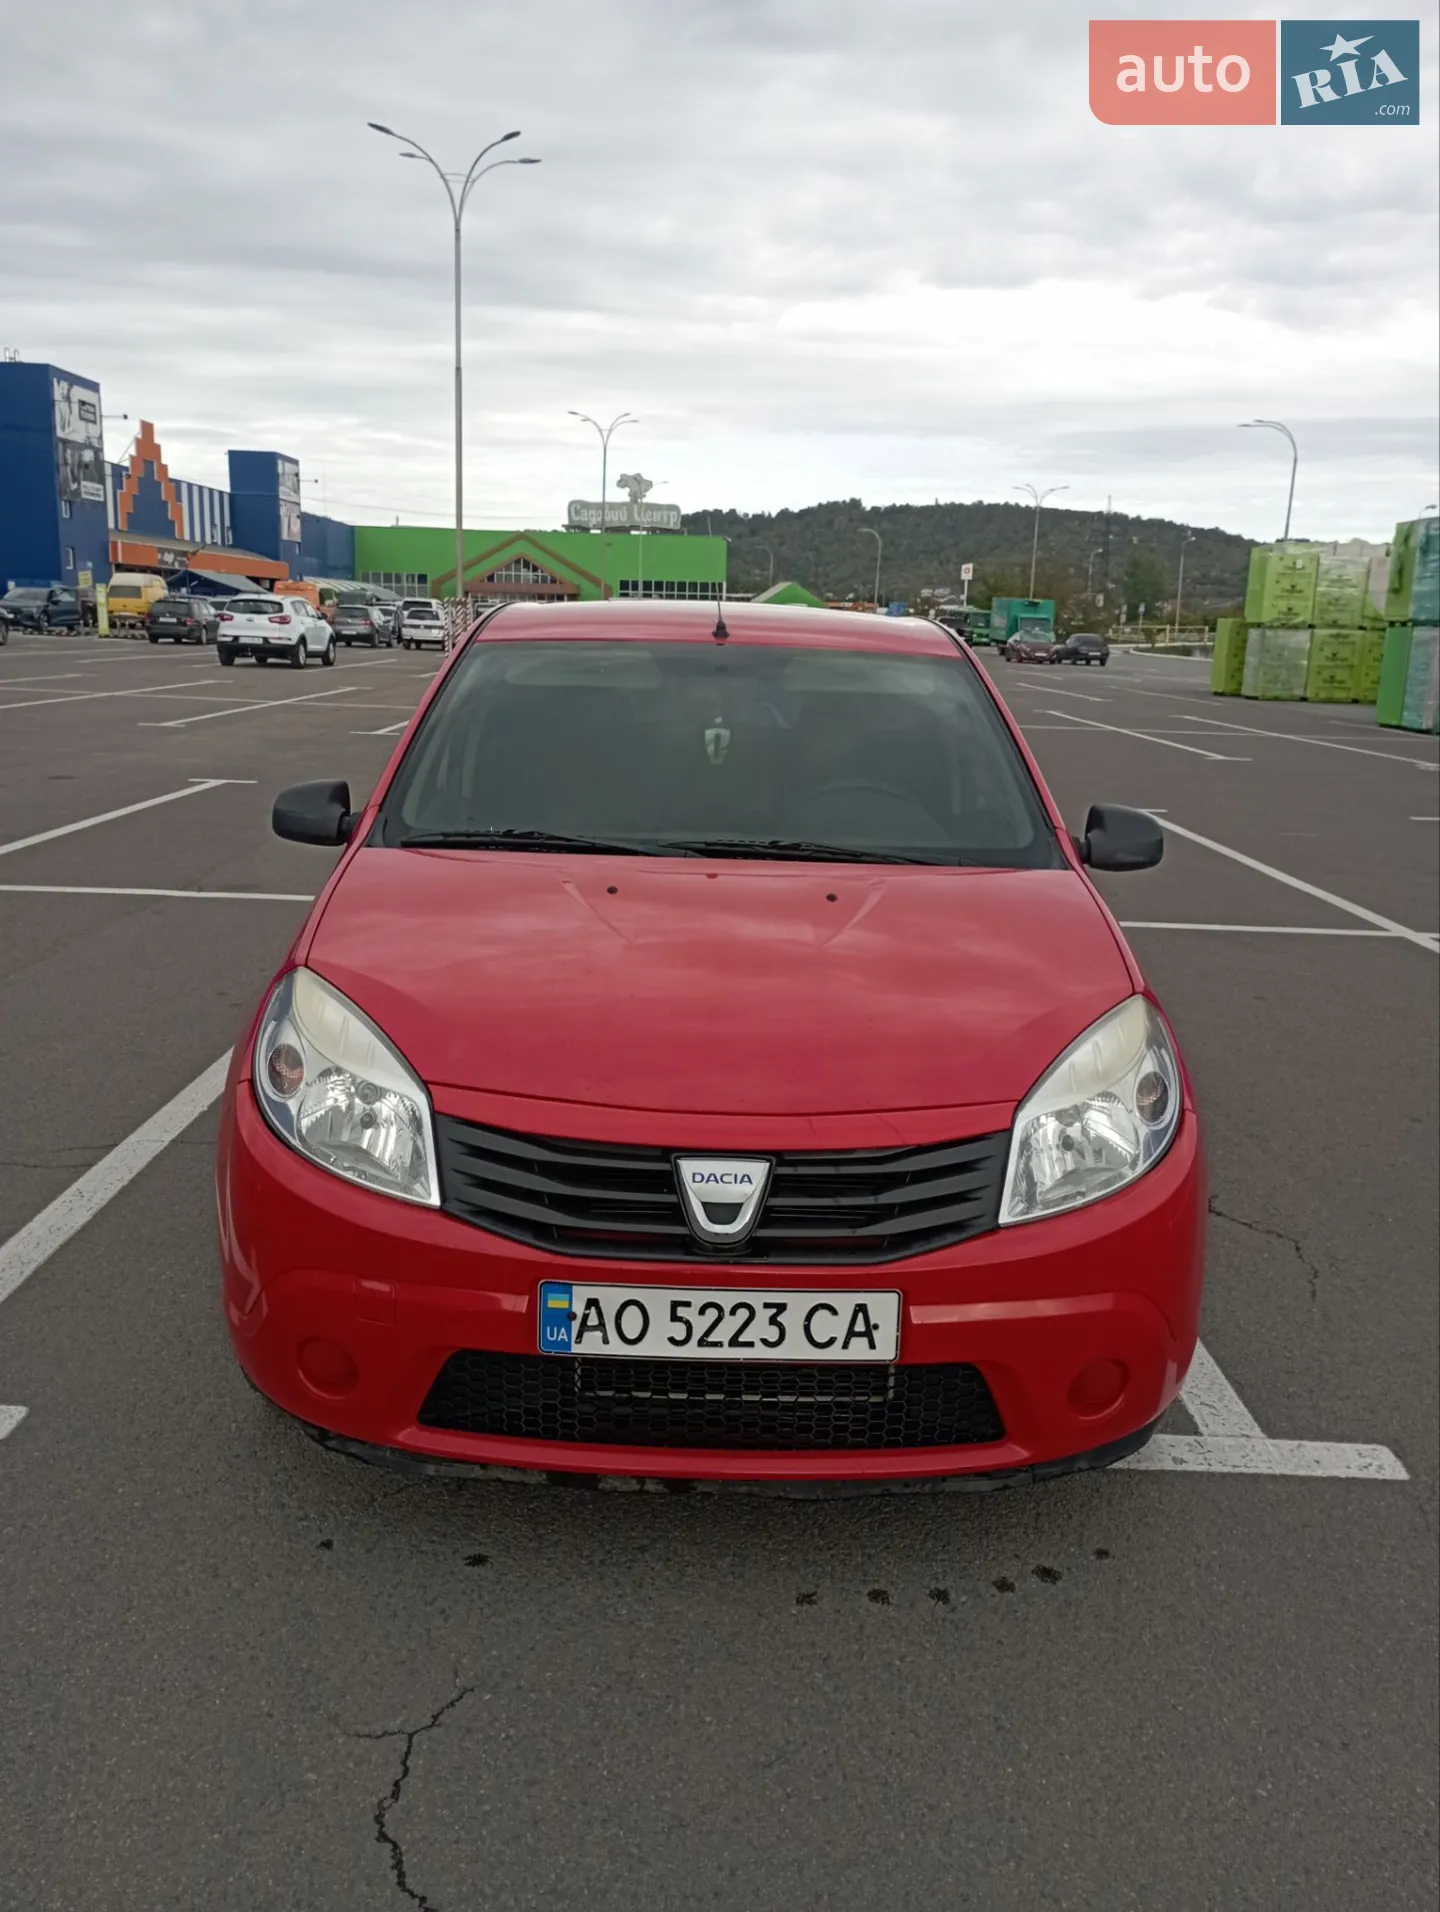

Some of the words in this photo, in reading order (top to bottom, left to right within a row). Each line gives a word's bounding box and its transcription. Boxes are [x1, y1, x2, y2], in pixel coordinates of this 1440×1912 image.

[632, 504, 678, 529] Центр
[692, 1172, 754, 1186] DACIA
[574, 1297, 650, 1346] AO
[667, 1300, 788, 1349] 5223
[803, 1302, 877, 1350] CA
[546, 1326, 568, 1343] UA
